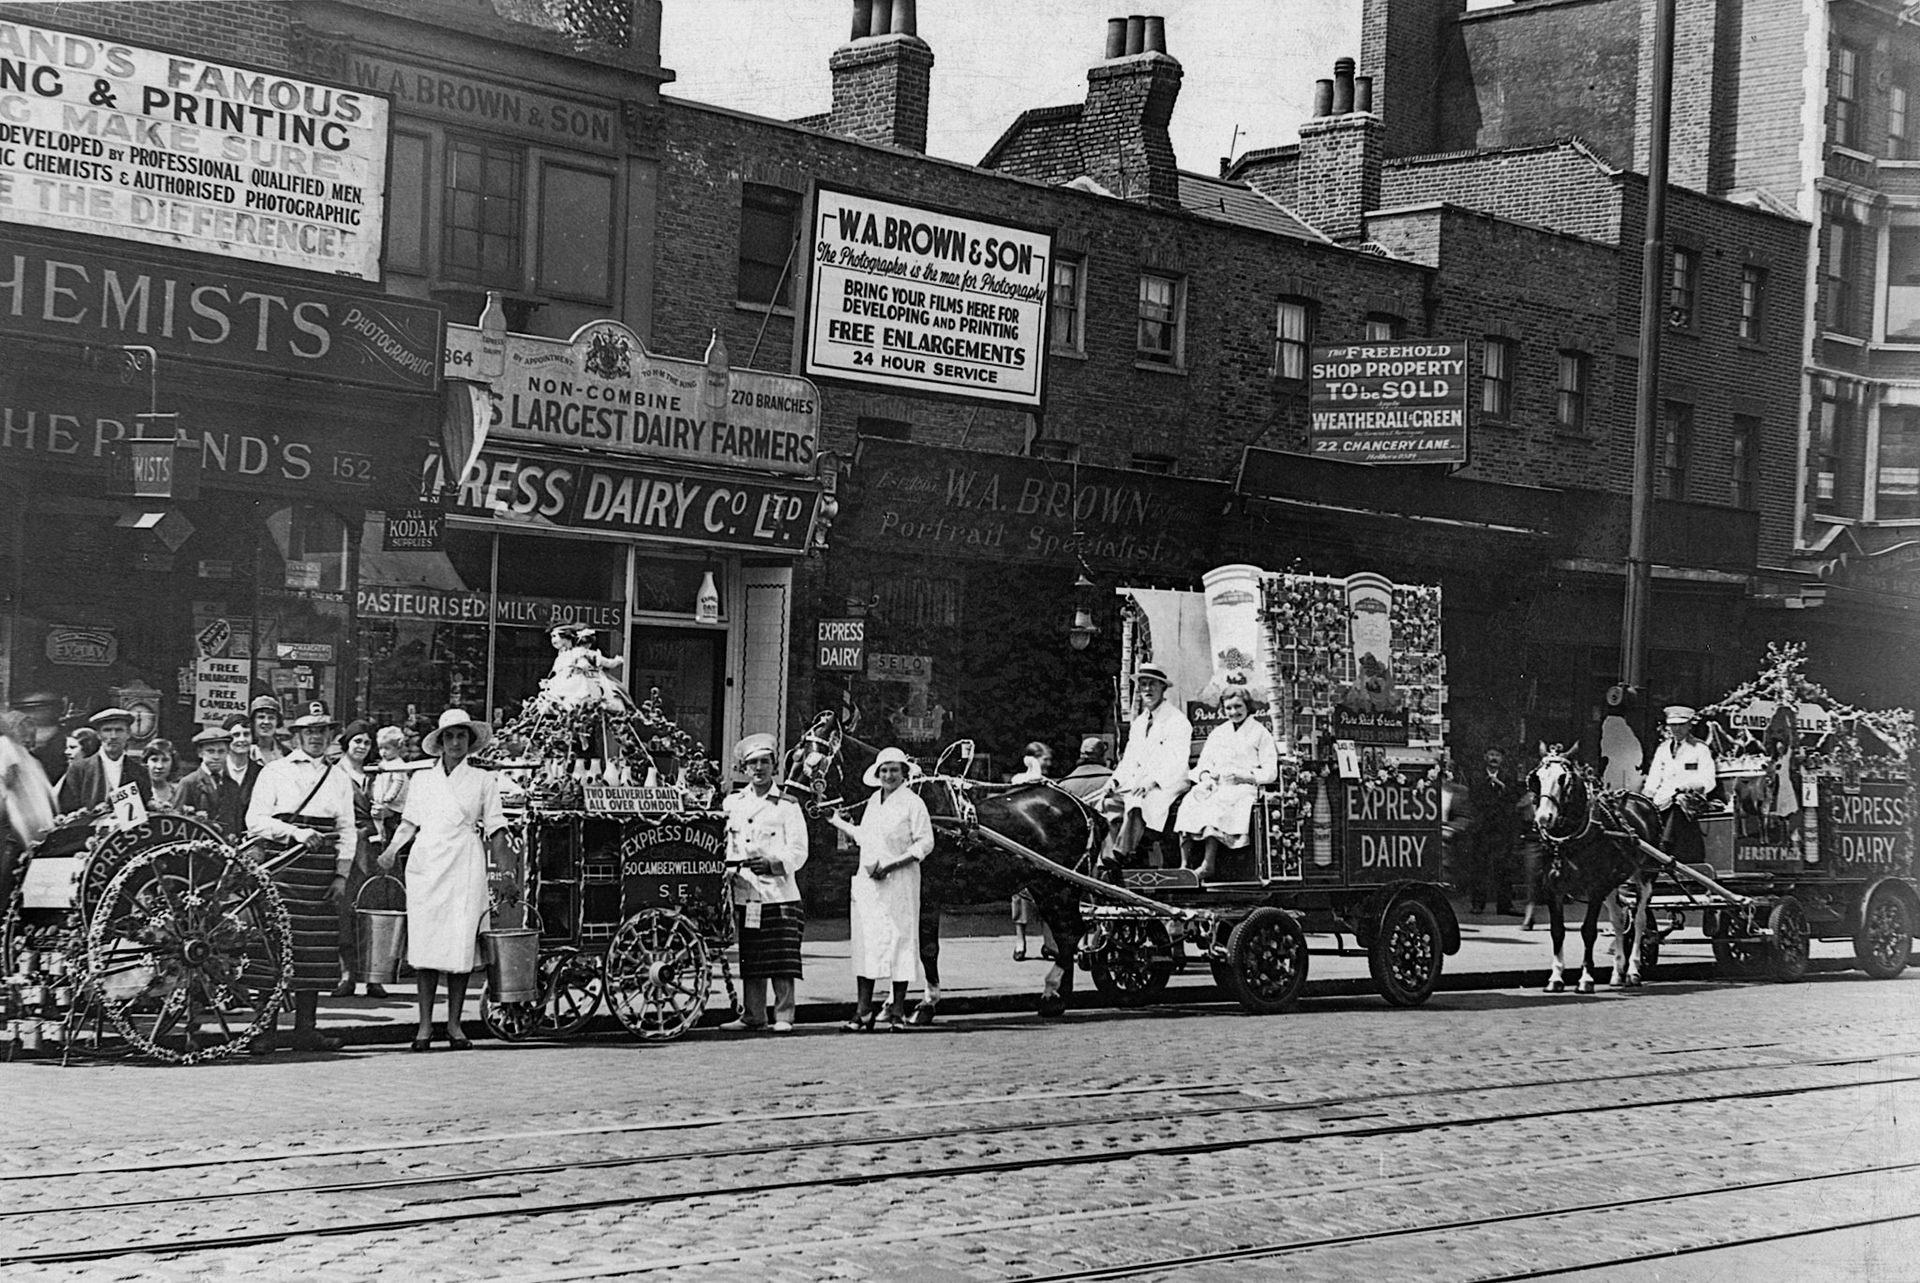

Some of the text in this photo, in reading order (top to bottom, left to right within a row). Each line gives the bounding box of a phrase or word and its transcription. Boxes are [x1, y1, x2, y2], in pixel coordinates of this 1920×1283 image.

[168, 58, 361, 122] FAMOUS
[88, 79, 117, 109] &
[142, 86, 350, 151] PRINTING
[417, 74, 521, 124] BROWN
[528, 107, 545, 128] &
[550, 105, 610, 142] SON
[62, 104, 200, 153] MAKE
[221, 135, 342, 180] SURE
[0, 123, 103, 157] DEVELOPED
[108, 148, 124, 162] BY
[130, 146, 243, 183] PROFESSIONAL
[251, 168, 324, 197] QUALIFIED
[24, 152, 113, 182] CHEMISTS
[134, 170, 235, 204] AUTHORISED
[246, 190, 361, 226] PHOTOGRAPHIC
[33, 178, 114, 218] THE
[131, 194, 348, 258] DIFFERENCE!
[968, 239, 982, 265] &
[984, 237, 1033, 275] SON
[816, 241, 1047, 306] The Photographer is the man for Photography
[844, 278, 1019, 323] BRING YOUR FILMS HERE FOR
[843, 297, 1019, 340] DEVELOPING AND PRINTING
[341, 309, 434, 376] PHOTOGRAPHIC
[829, 319, 1026, 366] FREE ENLARGEMENTS
[1346, 345, 1451, 359] FREEHOLD
[513, 353, 574, 366] BY APPOINTMENT
[853, 351, 997, 383] 24 HOUR SERVICE
[1312, 360, 1463, 379] SHOP PROPERTY
[528, 377, 681, 411] NON-COMBINE
[642, 370, 652, 378] TO
[679, 380, 697, 389] KING
[1325, 380, 1449, 400] TO be SOLD
[732, 390, 814, 414] 270 BRANCHES
[512, 394, 627, 441] LARGEST
[632, 411, 706, 450] DAIRY
[712, 421, 815, 463] FARMERS
[1312, 411, 1408, 431] WEATHERALL
[1343, 440, 1416, 451] CHANCERY
[1418, 439, 1450, 450] LANE
[406, 510, 424, 519] ALL
[583, 473, 701, 529] DAIRY
[392, 538, 433, 547] SUPPLIES
[879, 511, 1007, 547] Portrait
[357, 591, 486, 617] PASTEURISED
[497, 602, 537, 620] MILK
[551, 604, 621, 627] BOTTLES
[819, 622, 864, 641] EXPRESS
[209, 663, 239, 673] FREE
[820, 647, 861, 666] DAIRY
[878, 656, 922, 670] SELO
[200, 699, 246, 710] CAMERAS
[209, 690, 238, 700] FREE
[1346, 756, 1352, 772] 1
[586, 789, 680, 799] TWO DELIVERIES DAILY
[589, 800, 680, 810] ALL OVER LONDON
[1347, 785, 1438, 820] EXPRESS
[1831, 795, 1904, 826] EXPRESS
[625, 825, 722, 857] EXPRESS DAIRY
[1361, 835, 1427, 868] DAIRY
[1737, 846, 1780, 860] JERSEY
[1843, 836, 1896, 863] DAIRY
[87, 825, 152, 903] EXPRESS
[625, 861, 725, 875] 50 CAMBERWELL ROAD
